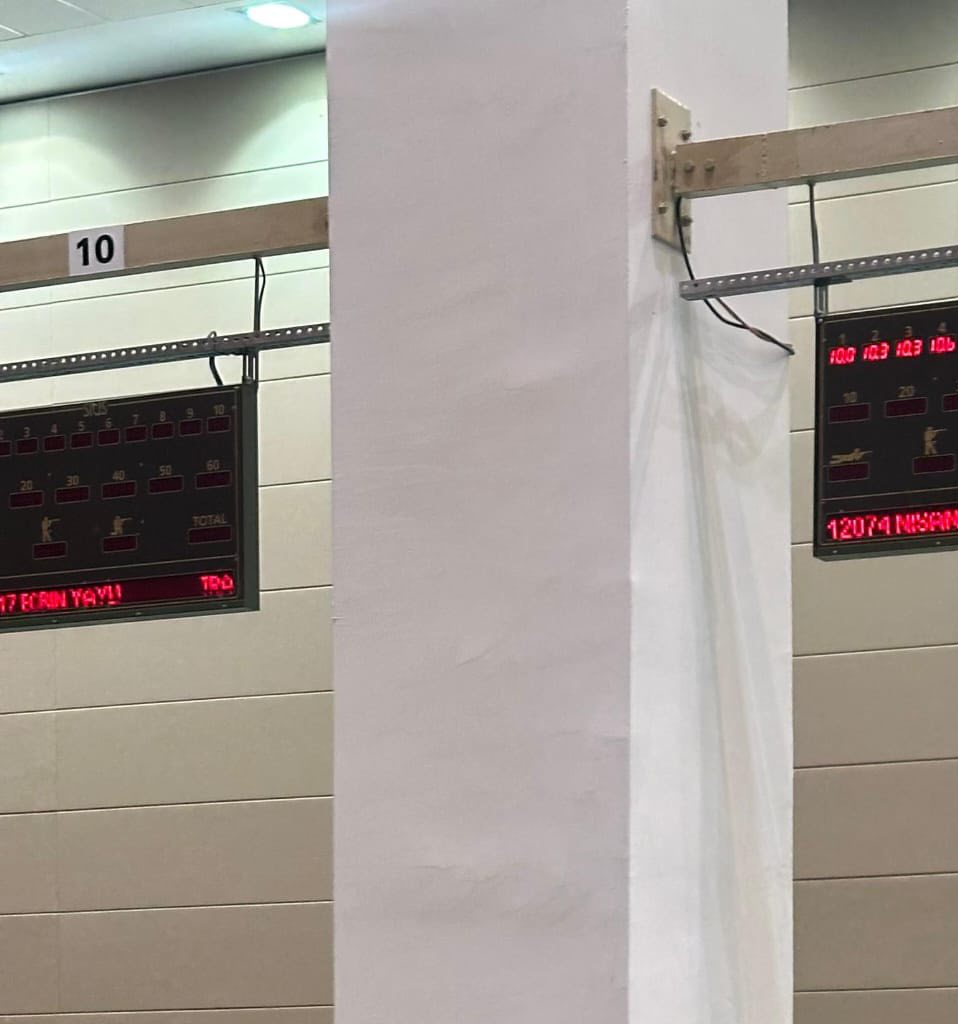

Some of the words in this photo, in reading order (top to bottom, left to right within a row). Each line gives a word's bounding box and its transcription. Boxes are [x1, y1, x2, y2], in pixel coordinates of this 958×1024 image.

[75, 233, 115, 267] 10
[843, 391, 858, 403] 10
[899, 386, 915, 397] 20
[23, 427, 31, 438] 3
[51, 423, 58, 434] 4
[78, 421, 85, 431] 5
[105, 418, 112, 429] 6
[132, 414, 140, 425] 7
[160, 411, 167, 422] 8
[187, 408, 194, 418] 9
[214, 404, 225, 415] 10
[20, 480, 33, 491] 20
[66, 476, 80, 487] 30
[112, 470, 125, 481] 40
[159, 465, 173, 476] 50
[206, 459, 220, 471] 60
[192, 514, 227, 527] TOTAL
